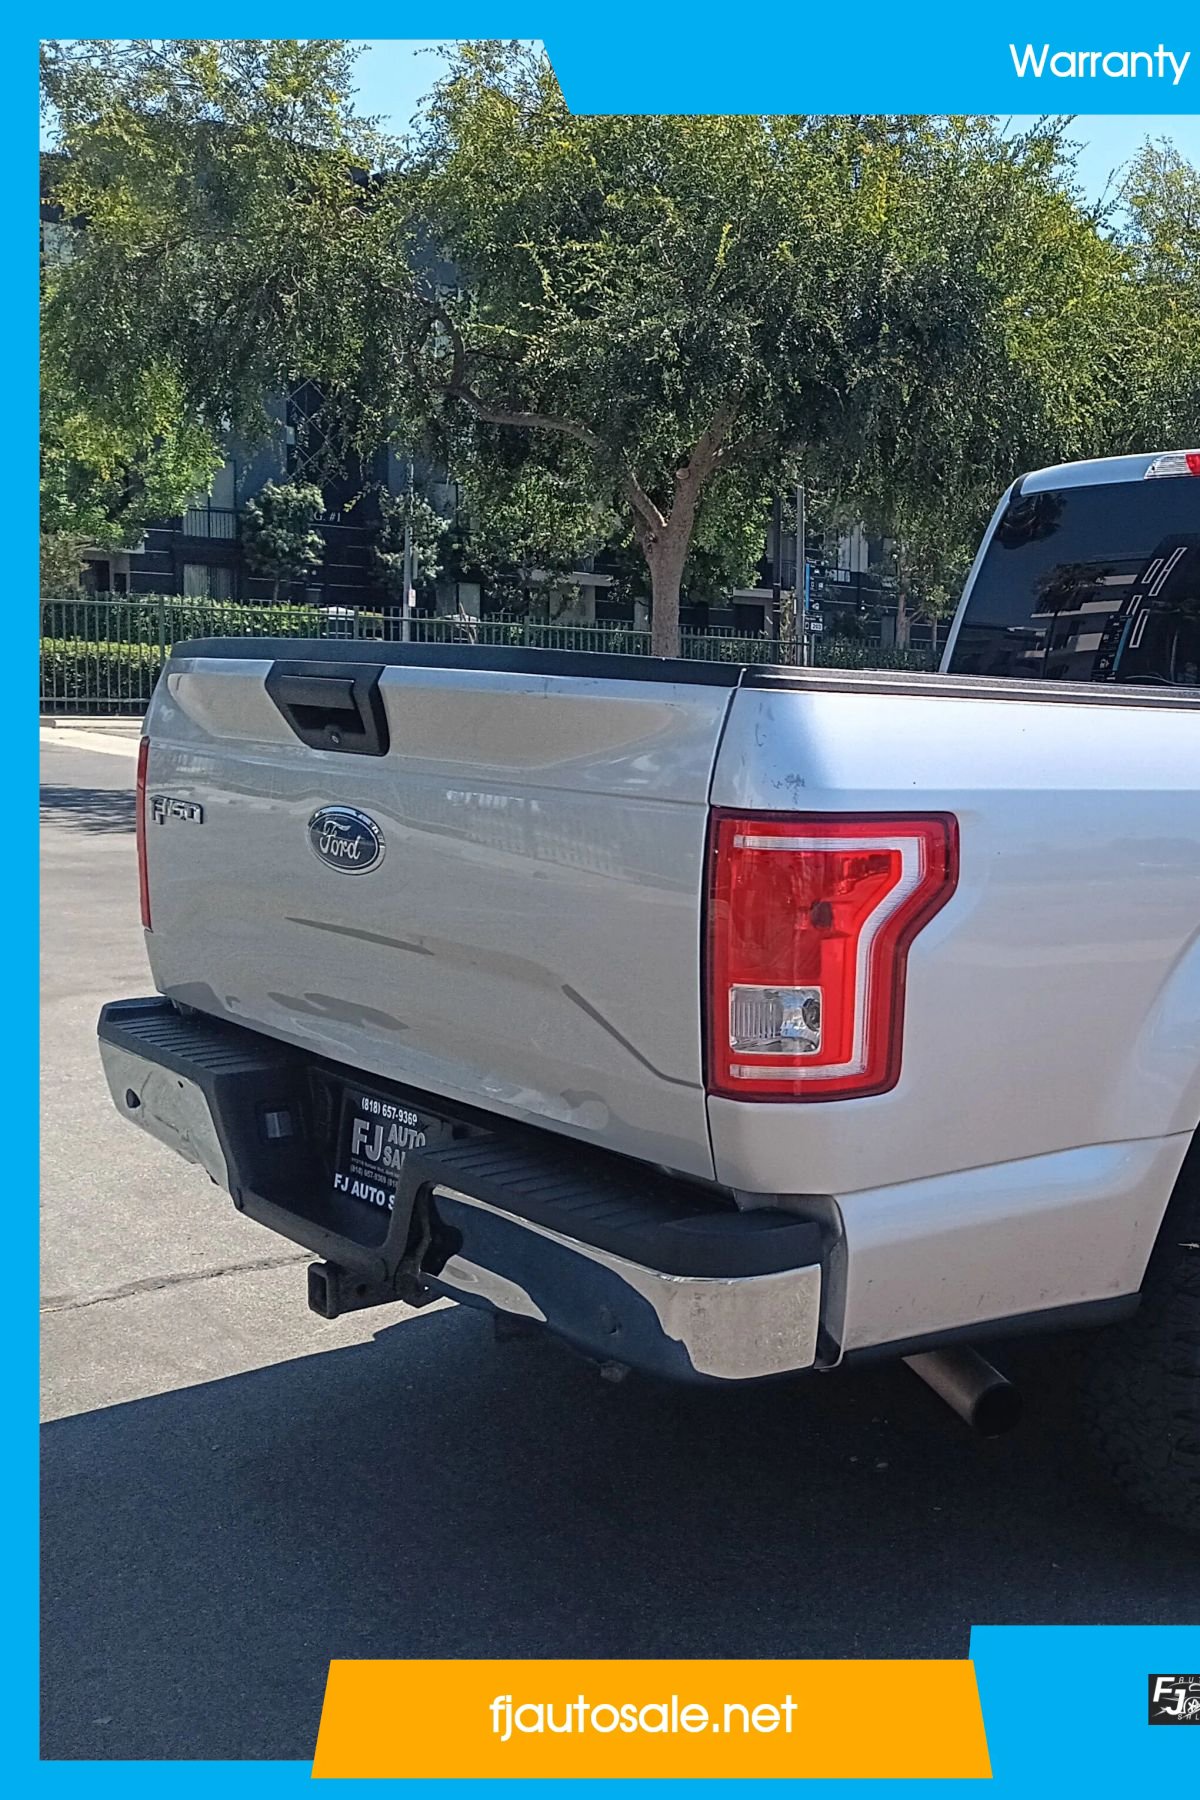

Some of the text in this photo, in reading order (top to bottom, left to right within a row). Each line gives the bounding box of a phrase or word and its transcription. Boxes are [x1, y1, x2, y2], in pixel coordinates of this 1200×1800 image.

[320, 821, 361, 860] Ford
[362, 1097, 418, 1126] (818) 657-9369
[351, 1118, 384, 1161] FJ
[387, 1123, 426, 1149] AUTO
[333, 1173, 349, 1191] FJ
[351, 1181, 385, 1206] AUTO
